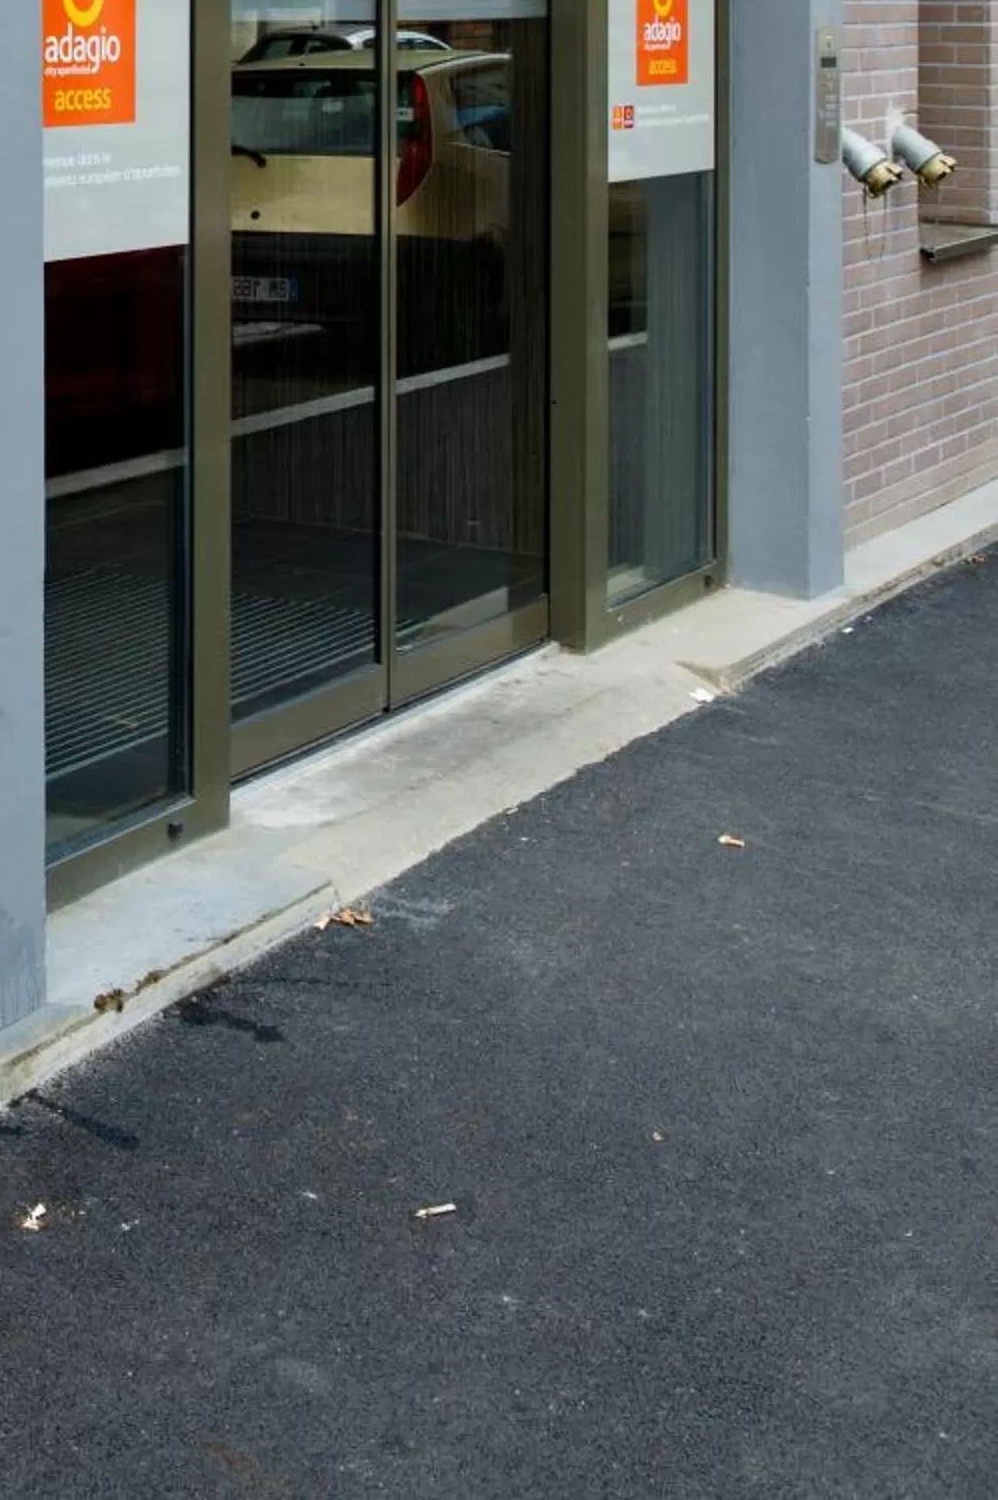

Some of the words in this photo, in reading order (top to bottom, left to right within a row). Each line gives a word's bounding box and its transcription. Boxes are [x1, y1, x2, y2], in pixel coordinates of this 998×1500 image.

[44, 20, 121, 76] adagio
[643, 13, 682, 51] adagio
[54, 87, 112, 113] access
